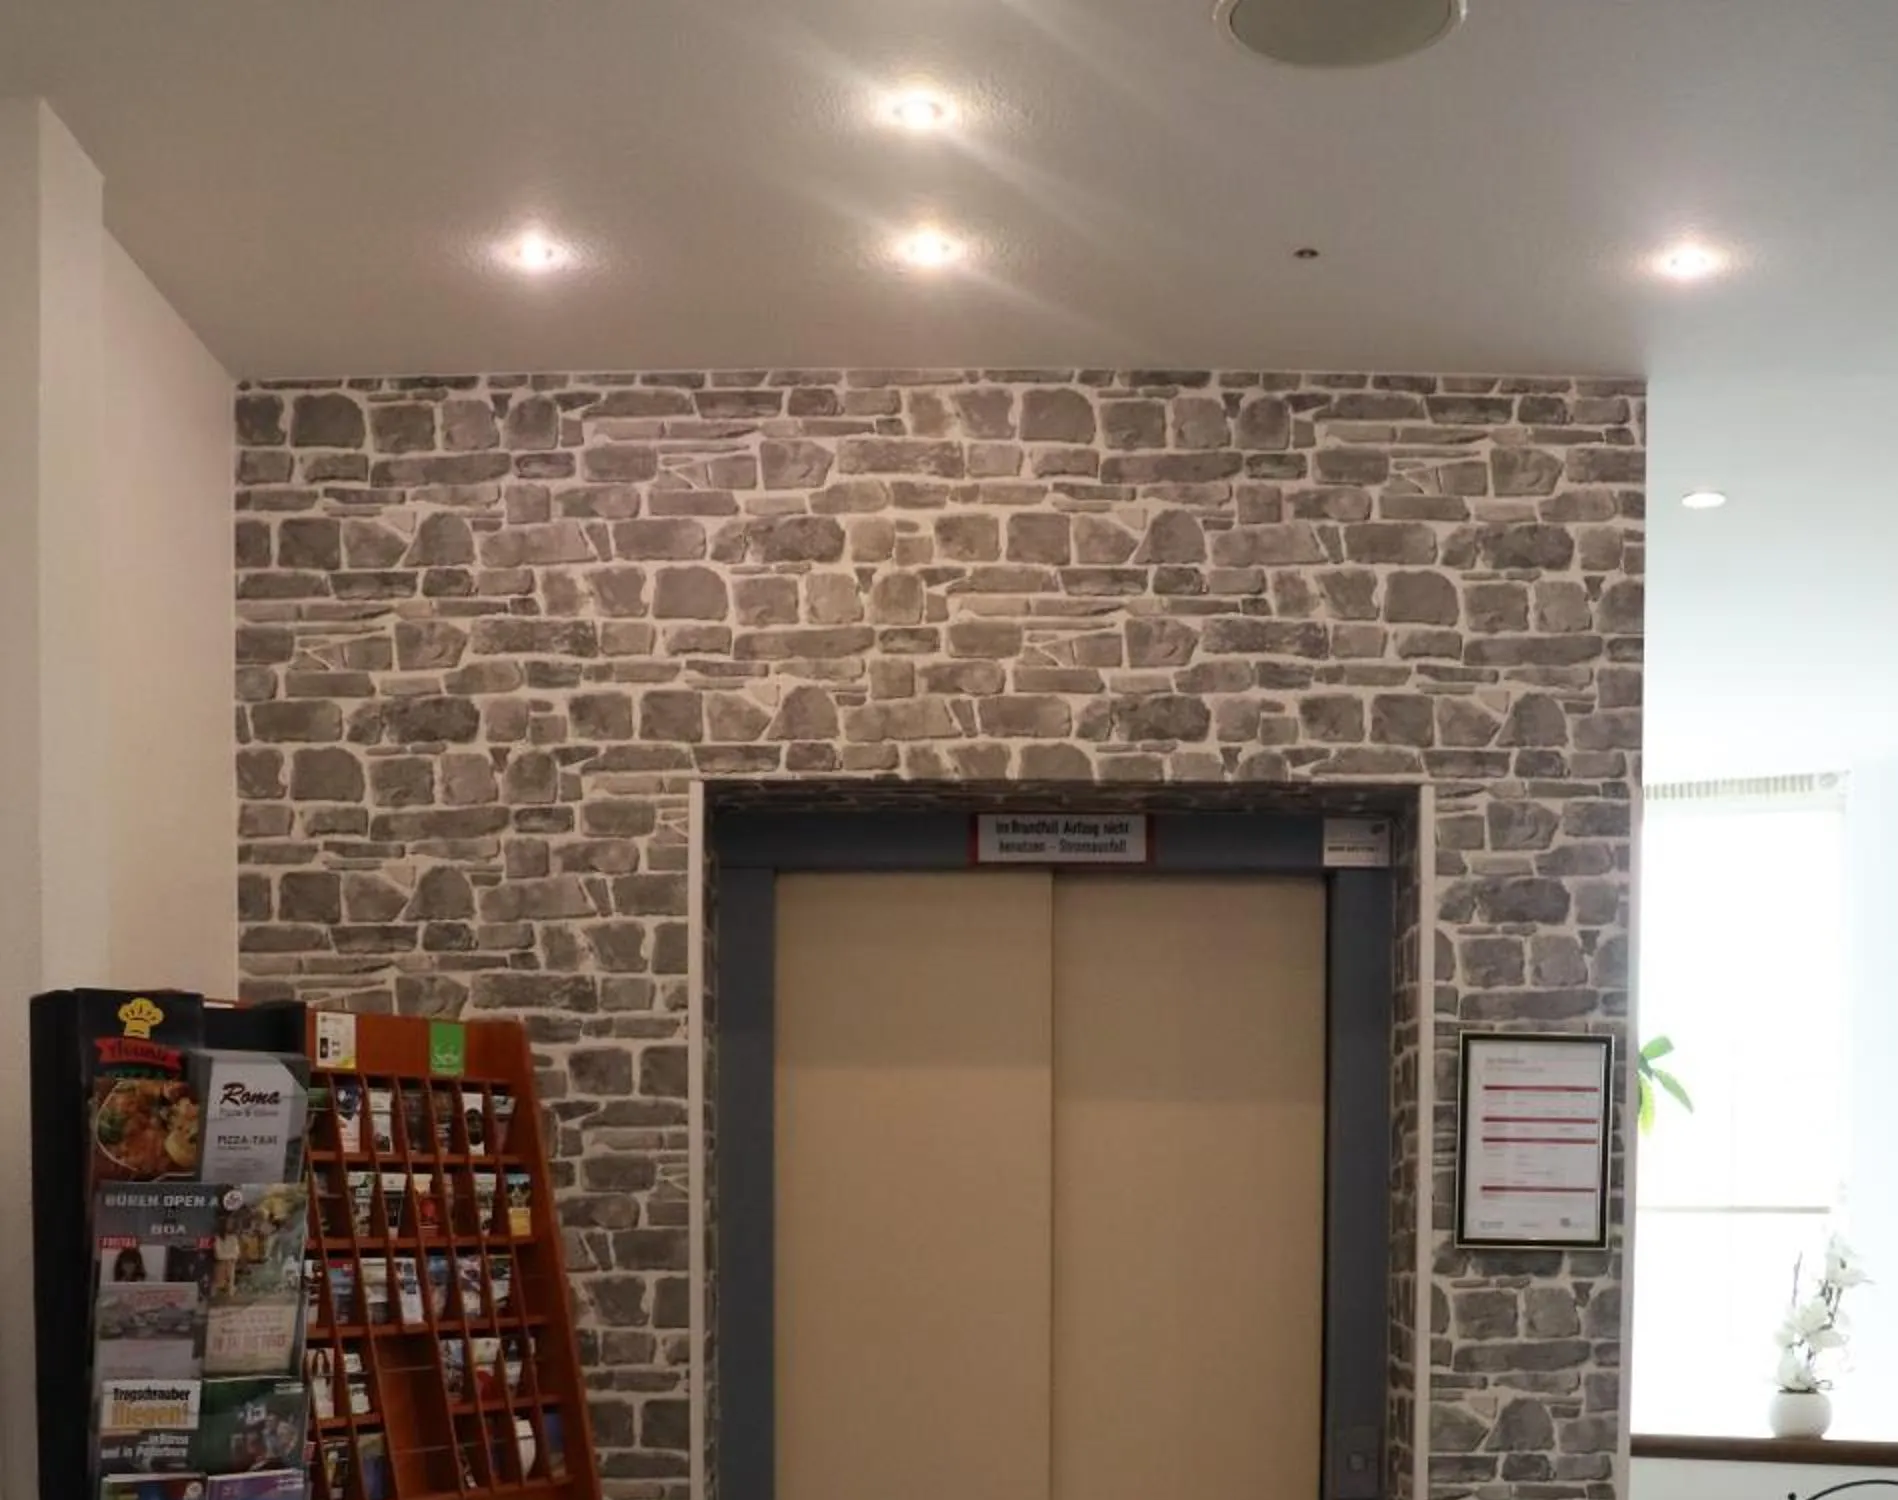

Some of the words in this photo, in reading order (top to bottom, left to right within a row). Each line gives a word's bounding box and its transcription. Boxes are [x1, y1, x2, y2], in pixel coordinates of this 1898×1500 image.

[1011, 819, 1058, 834] Brandfall
[1104, 819, 1130, 834] nicht
[1059, 839, 1127, 853] Stromausfall
[220, 1082, 281, 1107] Roma
